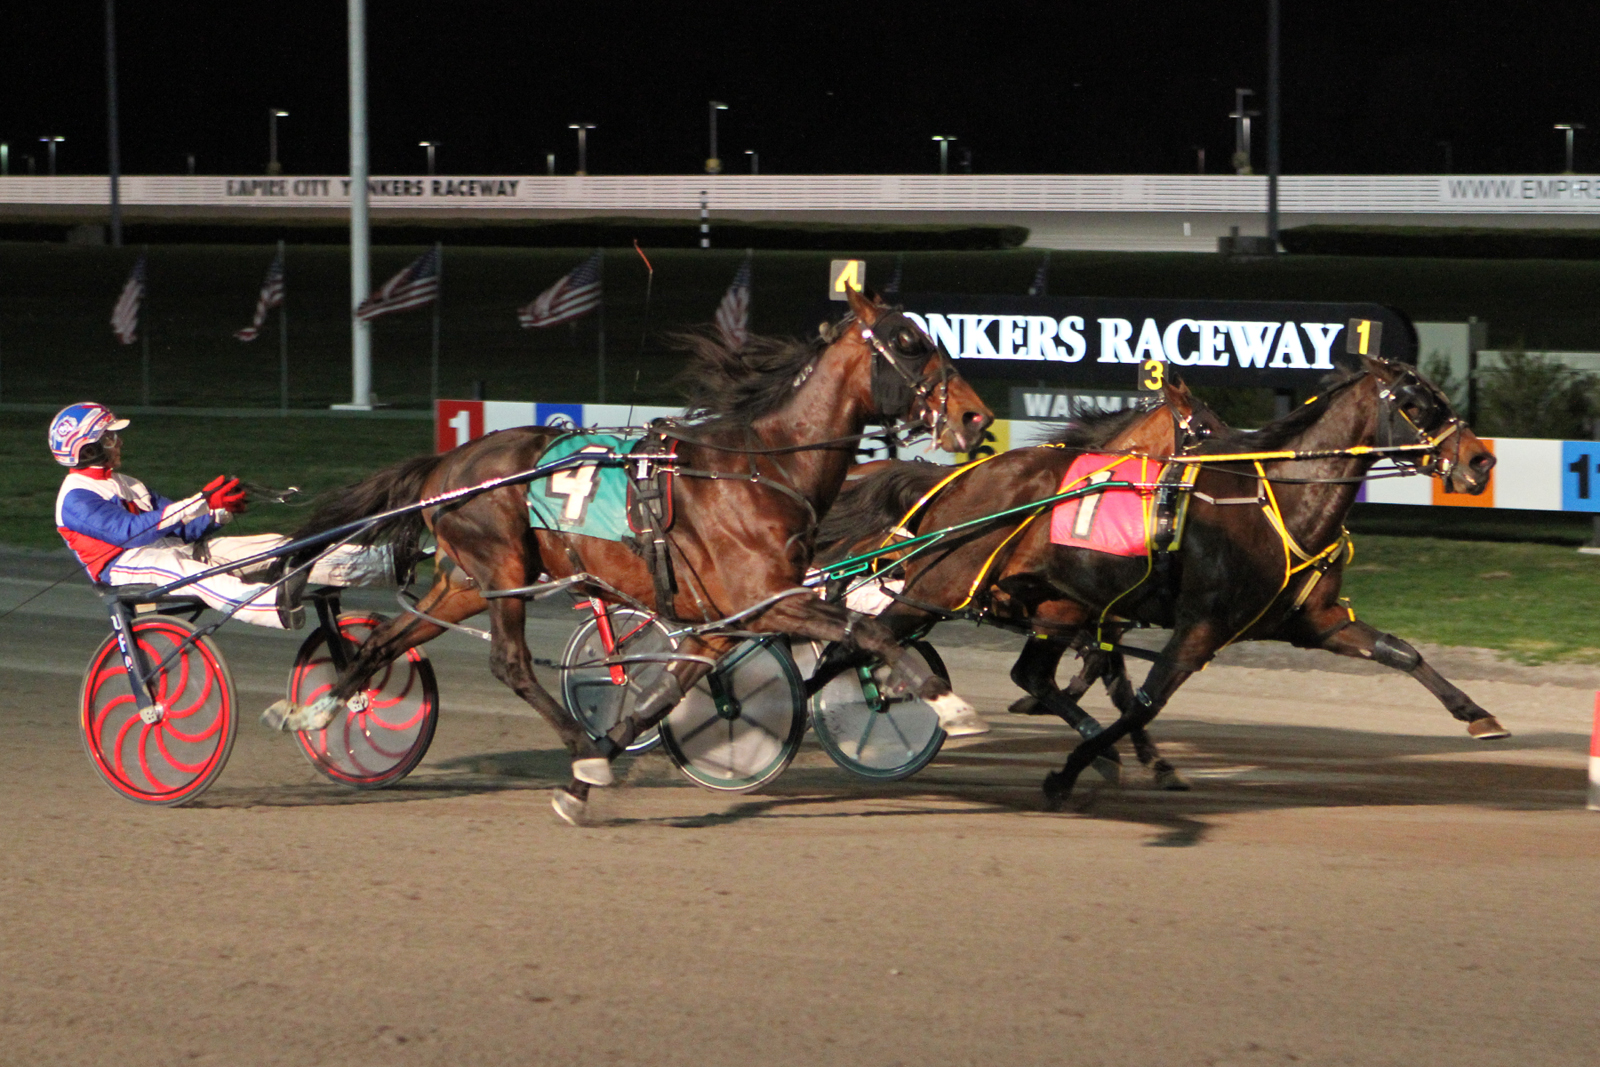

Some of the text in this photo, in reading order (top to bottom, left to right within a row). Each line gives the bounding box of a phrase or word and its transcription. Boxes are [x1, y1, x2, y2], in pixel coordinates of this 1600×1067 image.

[294, 179, 330, 197] CITY
[340, 180, 425, 197] YNKERS
[432, 180, 520, 197] RACEWAY
[835, 259, 862, 292] 4
[1096, 317, 1345, 370] RACEWAY
[1356, 319, 1371, 355] 1
[1143, 360, 1164, 390] 3
[448, 410, 471, 447] 1
[854, 424, 890, 465] 5
[551, 444, 608, 520] 4
[1568, 453, 1600, 500] 1
[1074, 470, 1112, 537] 1
